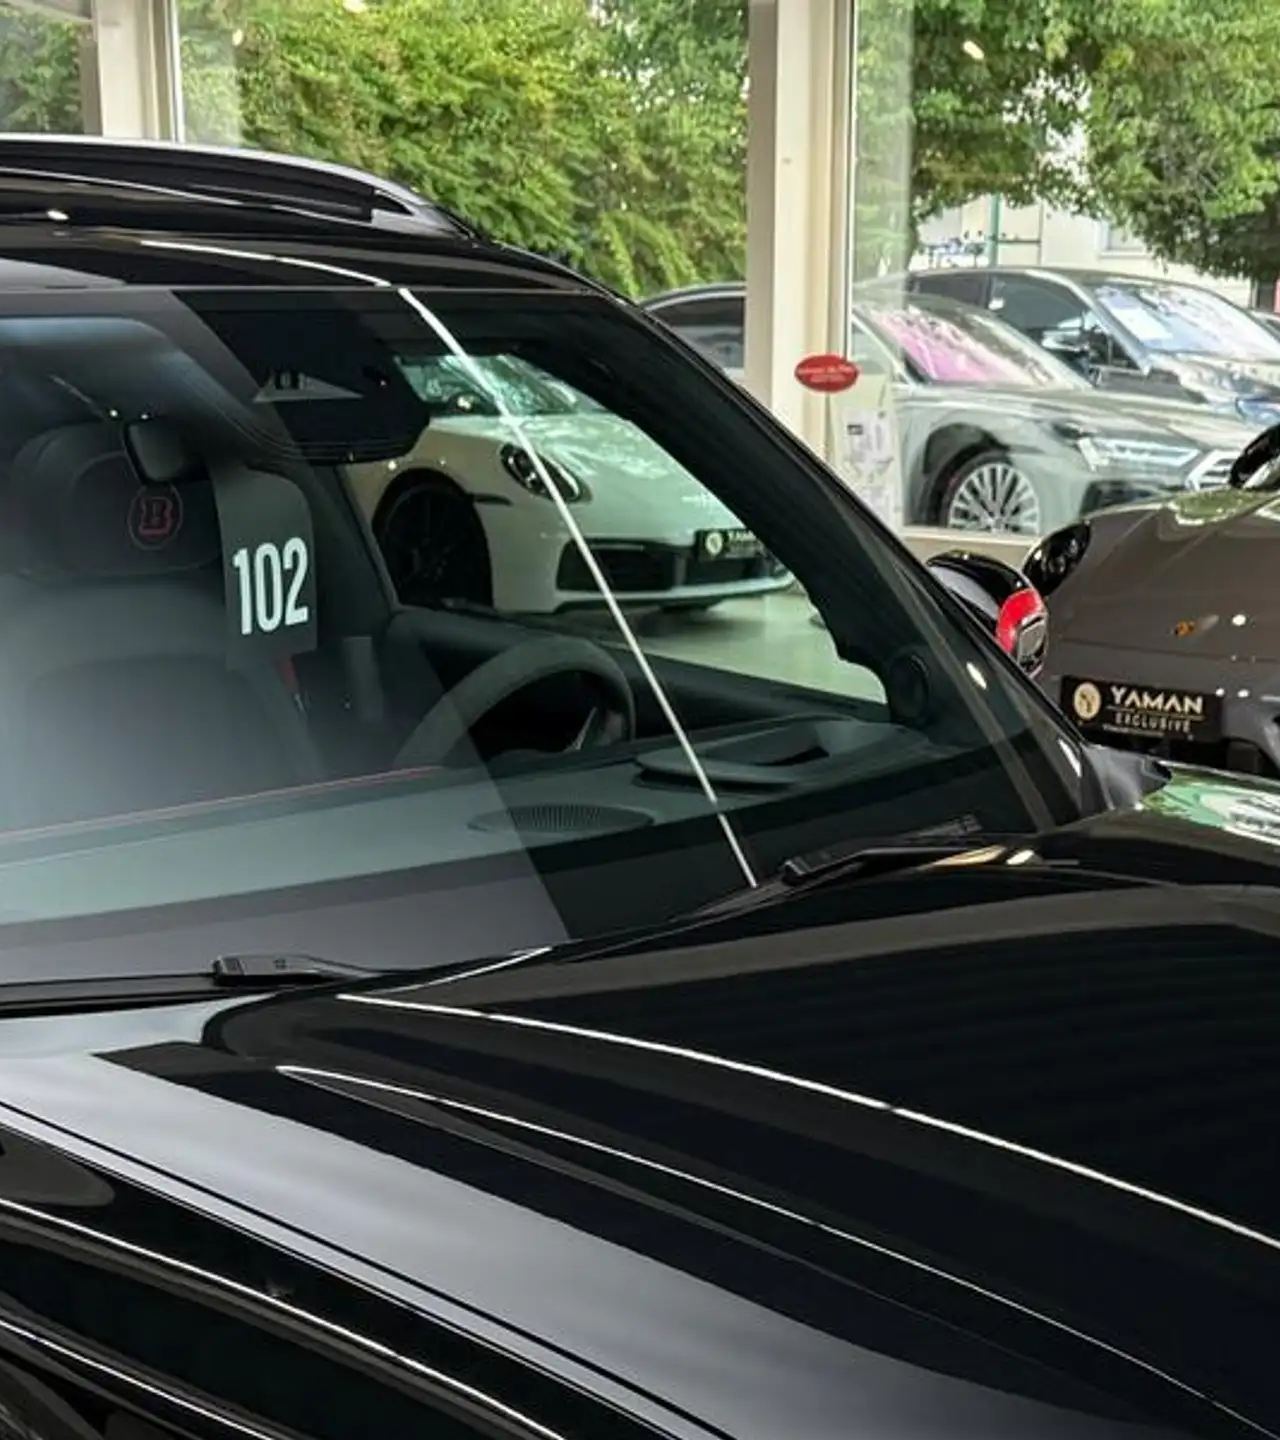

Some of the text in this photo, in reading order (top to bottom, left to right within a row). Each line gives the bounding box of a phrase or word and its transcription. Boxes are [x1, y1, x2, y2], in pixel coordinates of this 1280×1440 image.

[232, 536, 308, 635] 102
[1110, 685, 1203, 714] YAMAN
[1115, 712, 1191, 734] EXCLUSIVE
